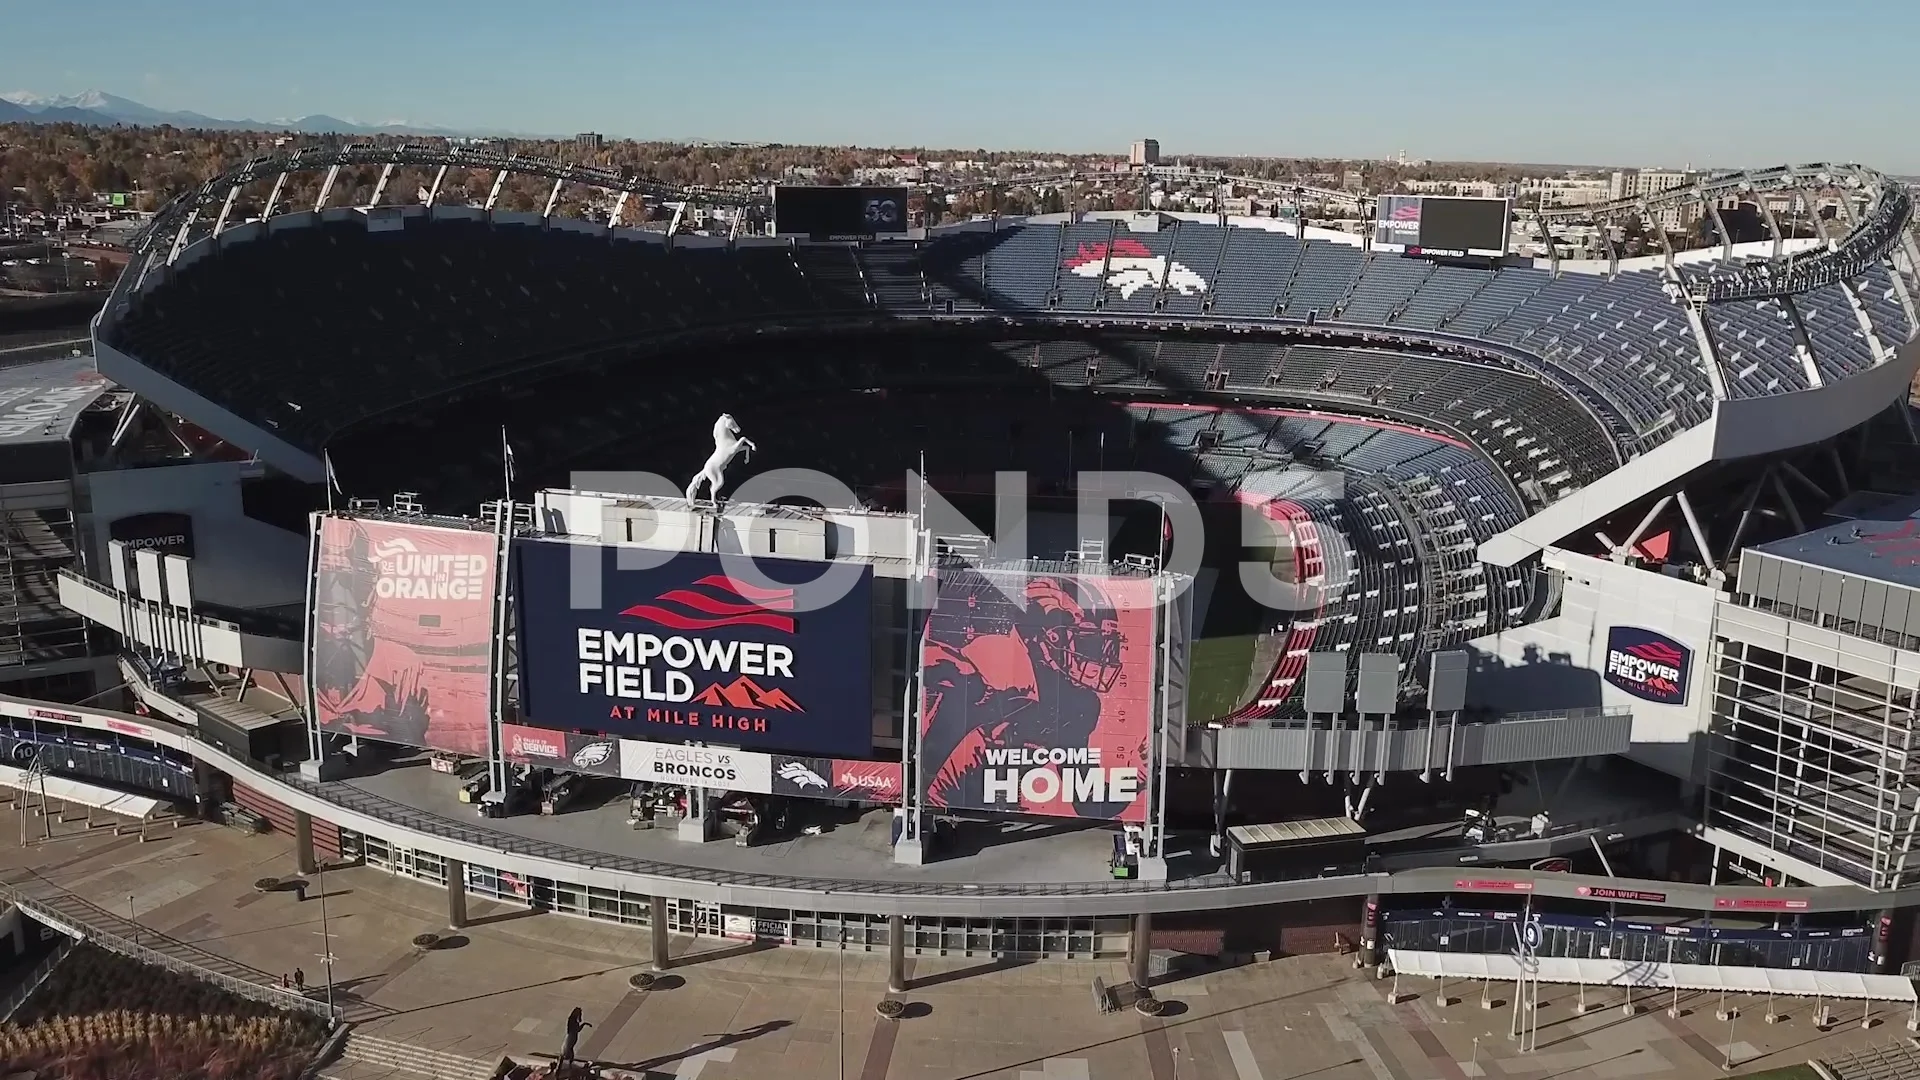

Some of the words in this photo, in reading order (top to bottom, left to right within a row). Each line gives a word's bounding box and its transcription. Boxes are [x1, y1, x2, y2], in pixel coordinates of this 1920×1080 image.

[1379, 220, 1419, 230] EMPOWER
[1421, 248, 1447, 256] EMPOWER
[1448, 249, 1464, 257] FIELD
[121, 535, 185, 549] MPOWER
[396, 554, 488, 577] UNITED
[376, 577, 483, 600] ORANGE
[578, 627, 794, 678] EMPOWER
[1608, 662, 1646, 682] FIELD
[1610, 650, 1679, 682] EMPOWER
[580, 662, 695, 703] FIELD
[1629, 680, 1645, 691] MILE
[1648, 688, 1667, 698] HIGH
[610, 705, 635, 720] AT
[647, 710, 699, 726] MILE
[712, 713, 767, 732] HIGH
[17, 747, 34, 759] 10
[523, 742, 558, 754] SERVICE
[655, 747, 713, 764] EAGLES
[718, 755, 732, 764] VS
[985, 748, 1101, 765] WELCOME
[654, 766, 737, 780] BRONCOS
[859, 775, 892, 788] USAA
[983, 767, 1137, 803] HOME
[1594, 889, 1615, 897] JOIN
[1618, 891, 1639, 899] WIFI
[751, 920, 787, 930] OFFICIAL
[1527, 928, 1535, 942] 9
